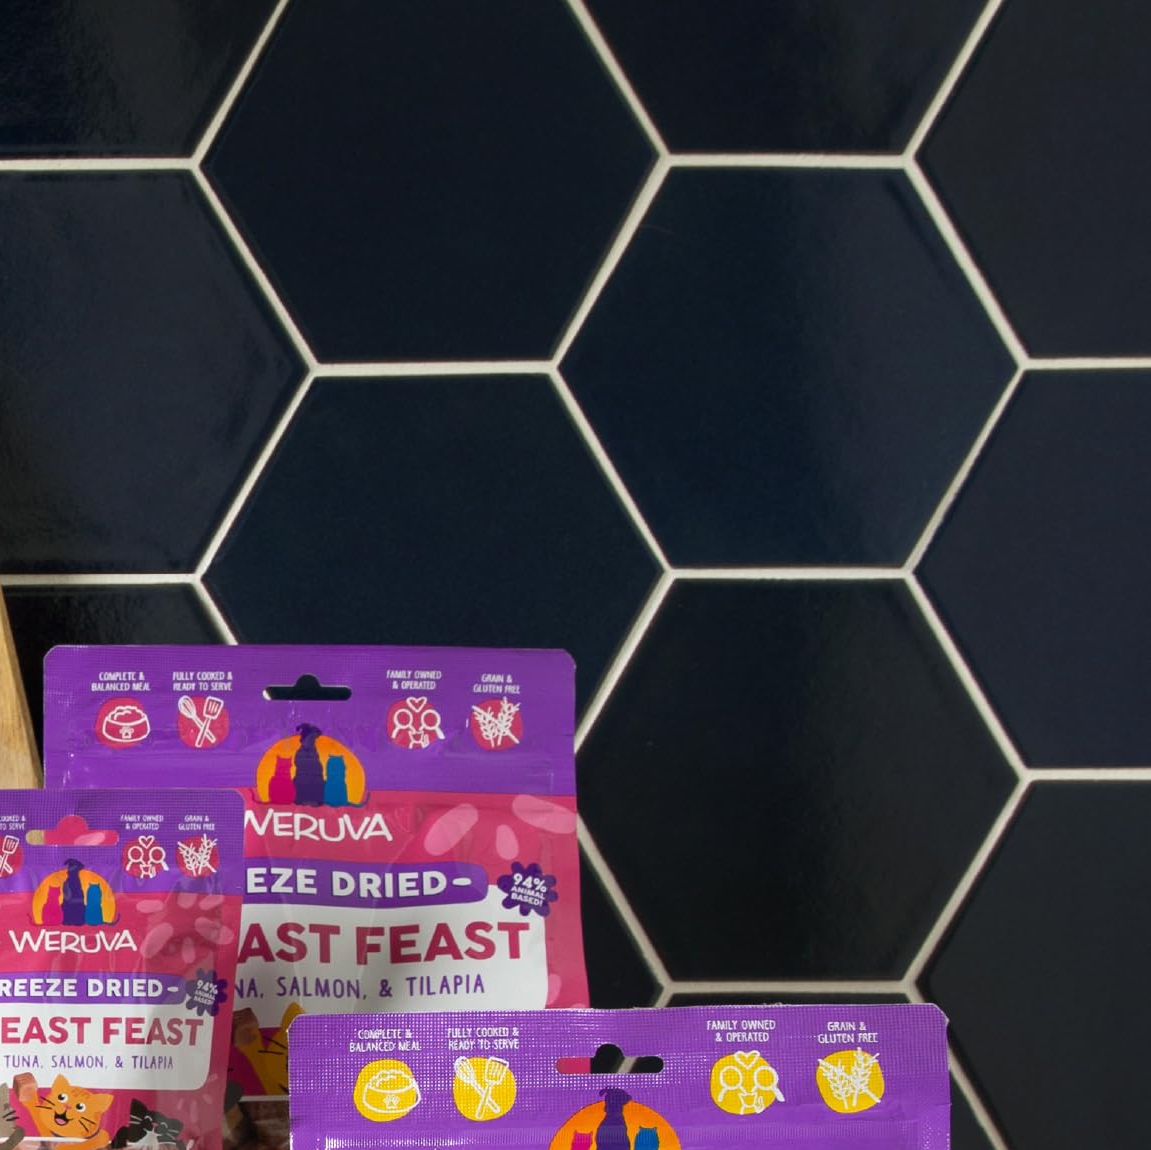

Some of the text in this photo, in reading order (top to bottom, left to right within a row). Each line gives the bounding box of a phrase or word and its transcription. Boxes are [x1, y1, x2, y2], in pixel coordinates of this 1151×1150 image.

[99, 672, 136, 681] COMPLETE
[172, 672, 194, 681] FULLY
[197, 672, 224, 681] COOKED
[386, 670, 442, 680] FAMILY OWNED
[481, 674, 504, 682] GRAIN
[91, 682, 150, 691] BALANCED MEAL
[173, 682, 232, 691] READY TO SERVE
[401, 681, 436, 690] OPERATED
[473, 684, 521, 694] GLUTEN FREE
[513, 873, 547, 892] 94%
[511, 886, 546, 900] ANIMAL
[9, 929, 138, 954] WERUVA
[356, 921, 530, 965] FEAST
[277, 974, 485, 999] SALMON, & TILAPIA
[706, 1020, 776, 1030] FAMILY OWNED
[827, 1022, 856, 1031] GRAIN
[103, 1017, 204, 1048] FEAST
[358, 1028, 401, 1040] COMPLETE
[448, 1028, 472, 1039] FULLY
[476, 1027, 509, 1037] COOKED
[726, 1032, 769, 1042] OPERATED
[818, 1032, 878, 1044] GLUTEN FREE
[350, 1041, 421, 1052] BALANCED MEAL
[449, 1039, 519, 1050] READY TO SERVE
[4, 1055, 43, 1069] TUNA,
[51, 1055, 108, 1069] SALMON,
[115, 1055, 123, 1068] &
[132, 1055, 173, 1070] TILAPIA
